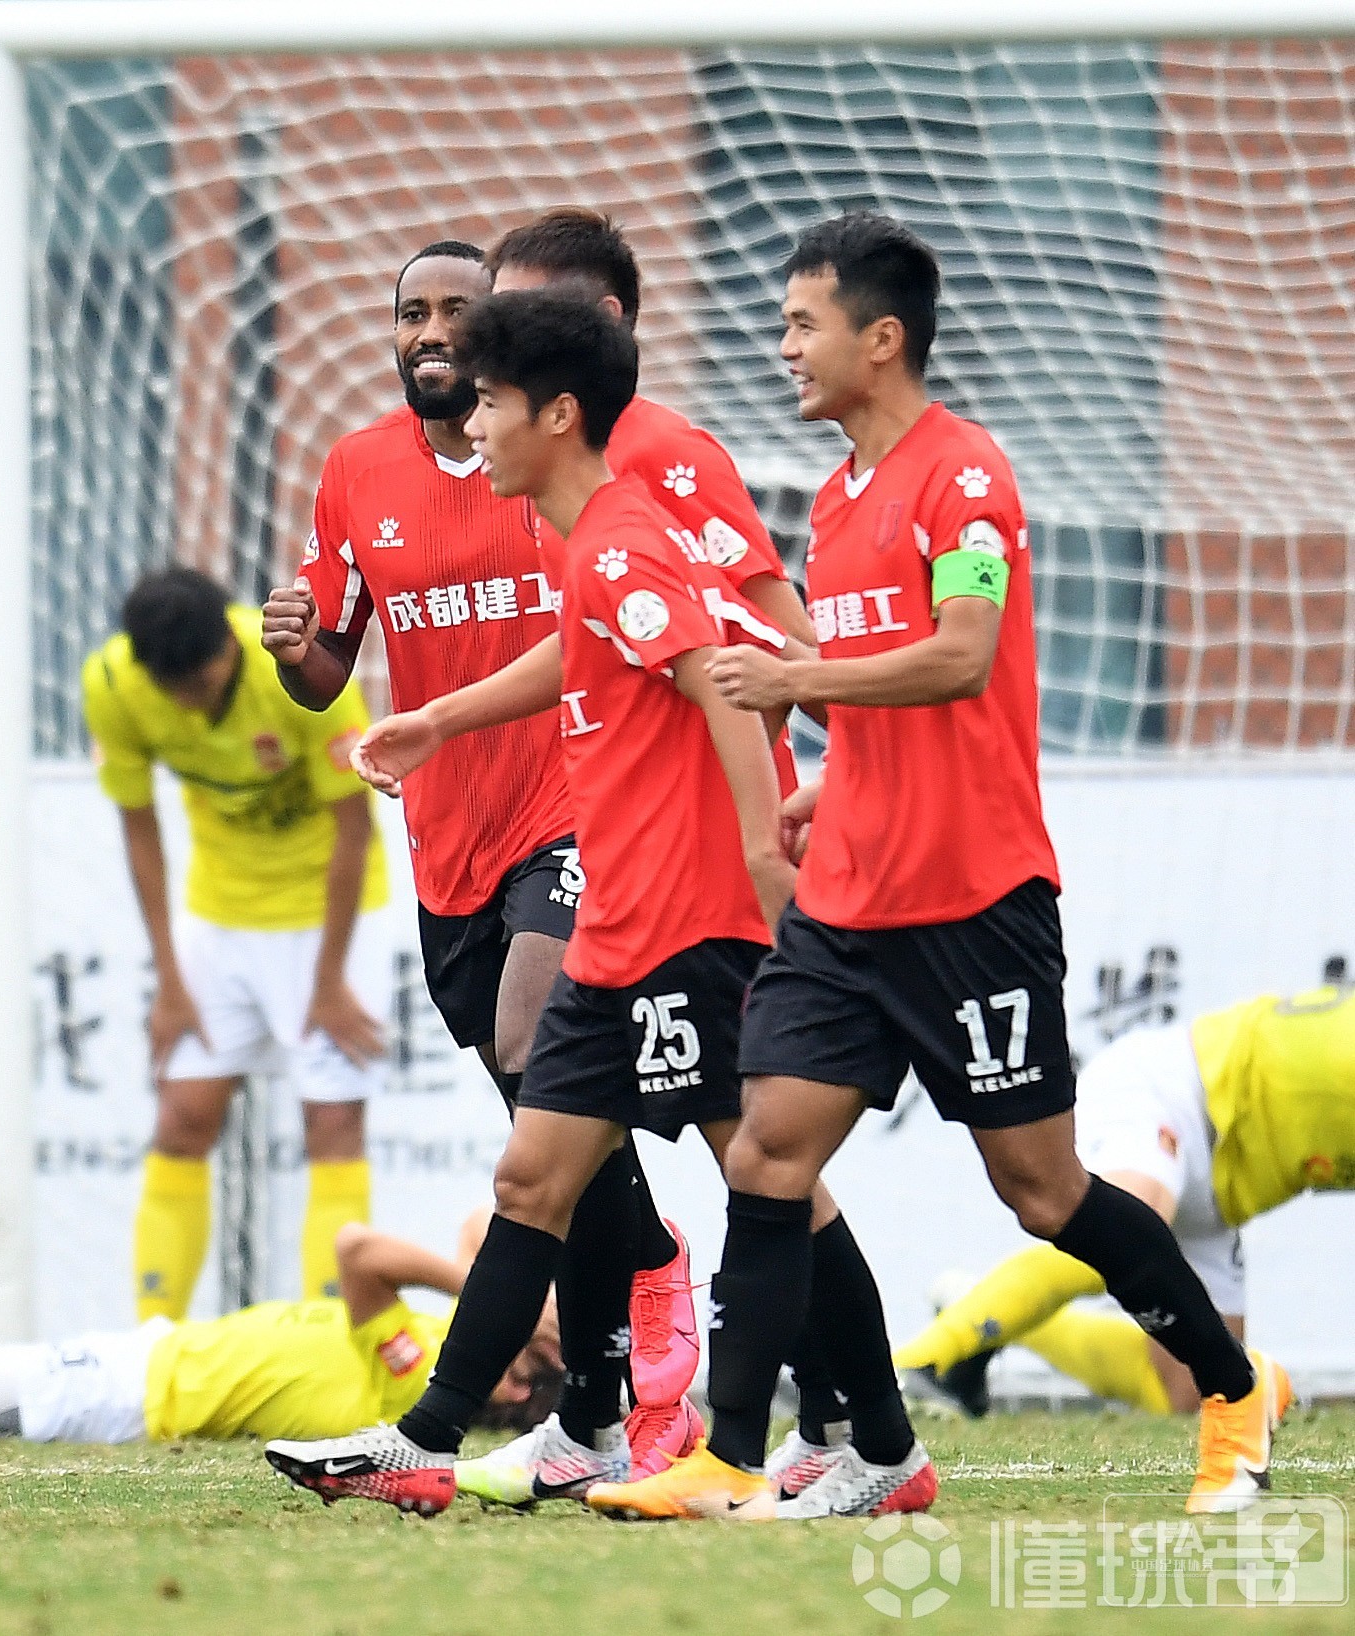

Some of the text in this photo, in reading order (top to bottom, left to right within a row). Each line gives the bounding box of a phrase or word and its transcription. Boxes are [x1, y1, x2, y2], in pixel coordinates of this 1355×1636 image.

[631, 991, 701, 1075] 25
[954, 987, 1031, 1077] 17
[638, 1070, 704, 1094] KELME
[969, 1065, 1044, 1094] KELME
